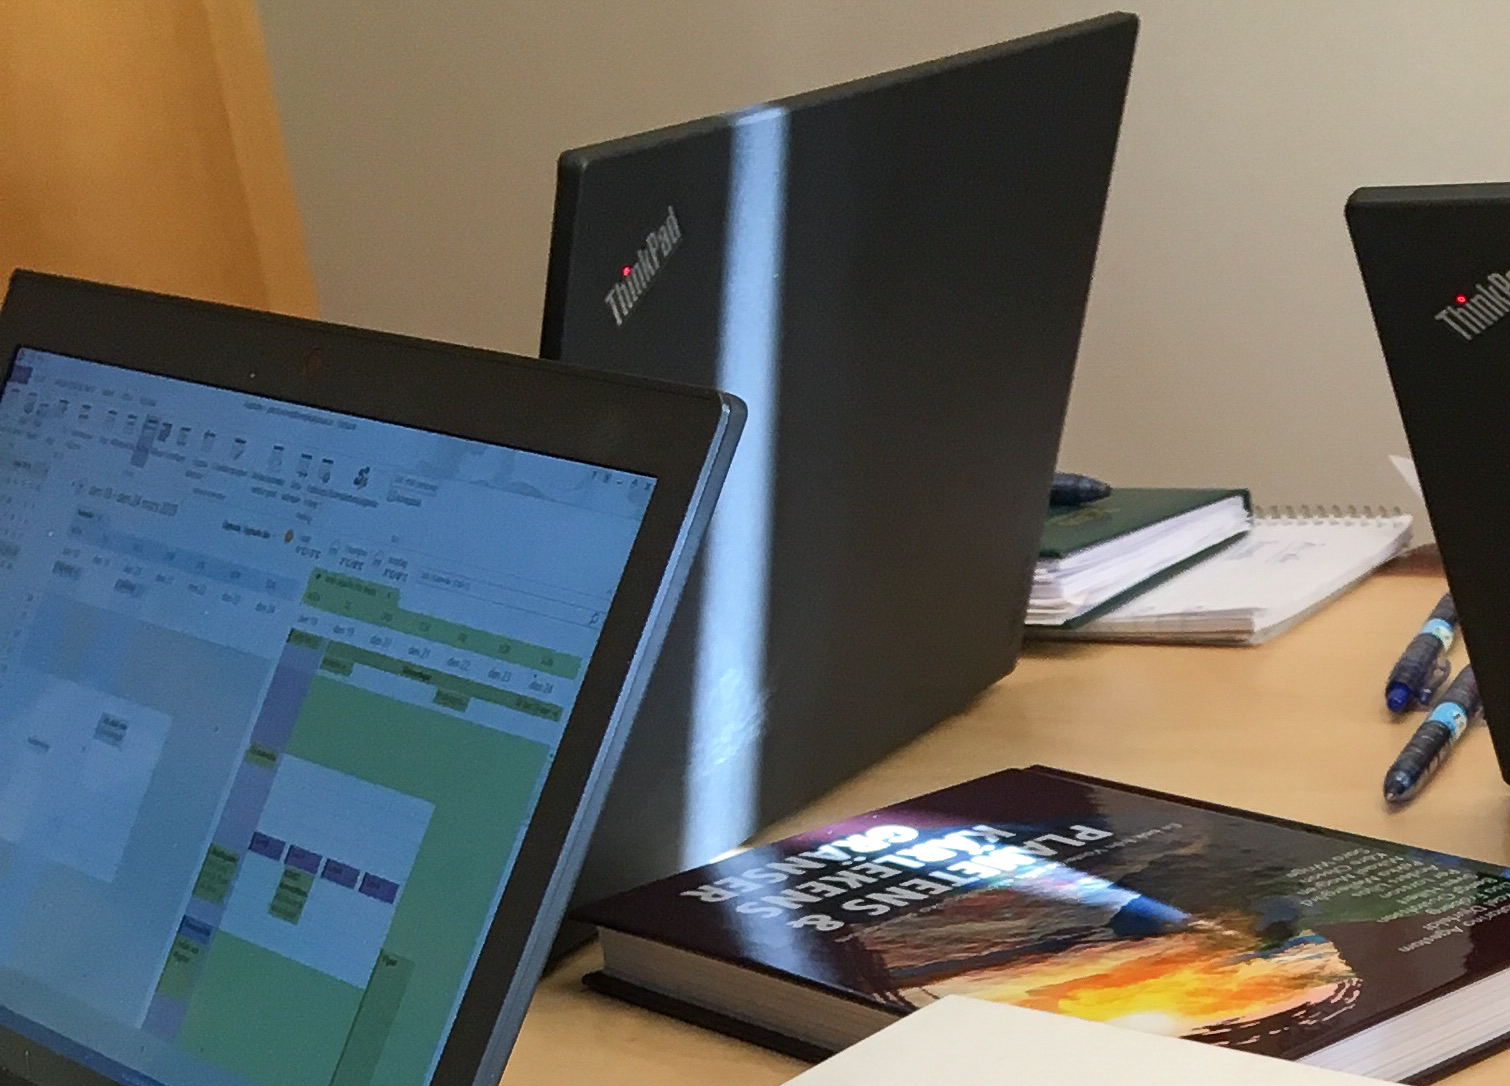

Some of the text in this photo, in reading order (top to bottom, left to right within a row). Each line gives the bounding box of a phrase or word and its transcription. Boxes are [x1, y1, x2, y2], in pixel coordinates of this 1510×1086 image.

[605, 205, 681, 325] ThinkPad
[689, 824, 919, 904] GRÄNSER
[735, 824, 1016, 919] KÄRLEKENS
[787, 824, 1112, 932] PLANETENS &
